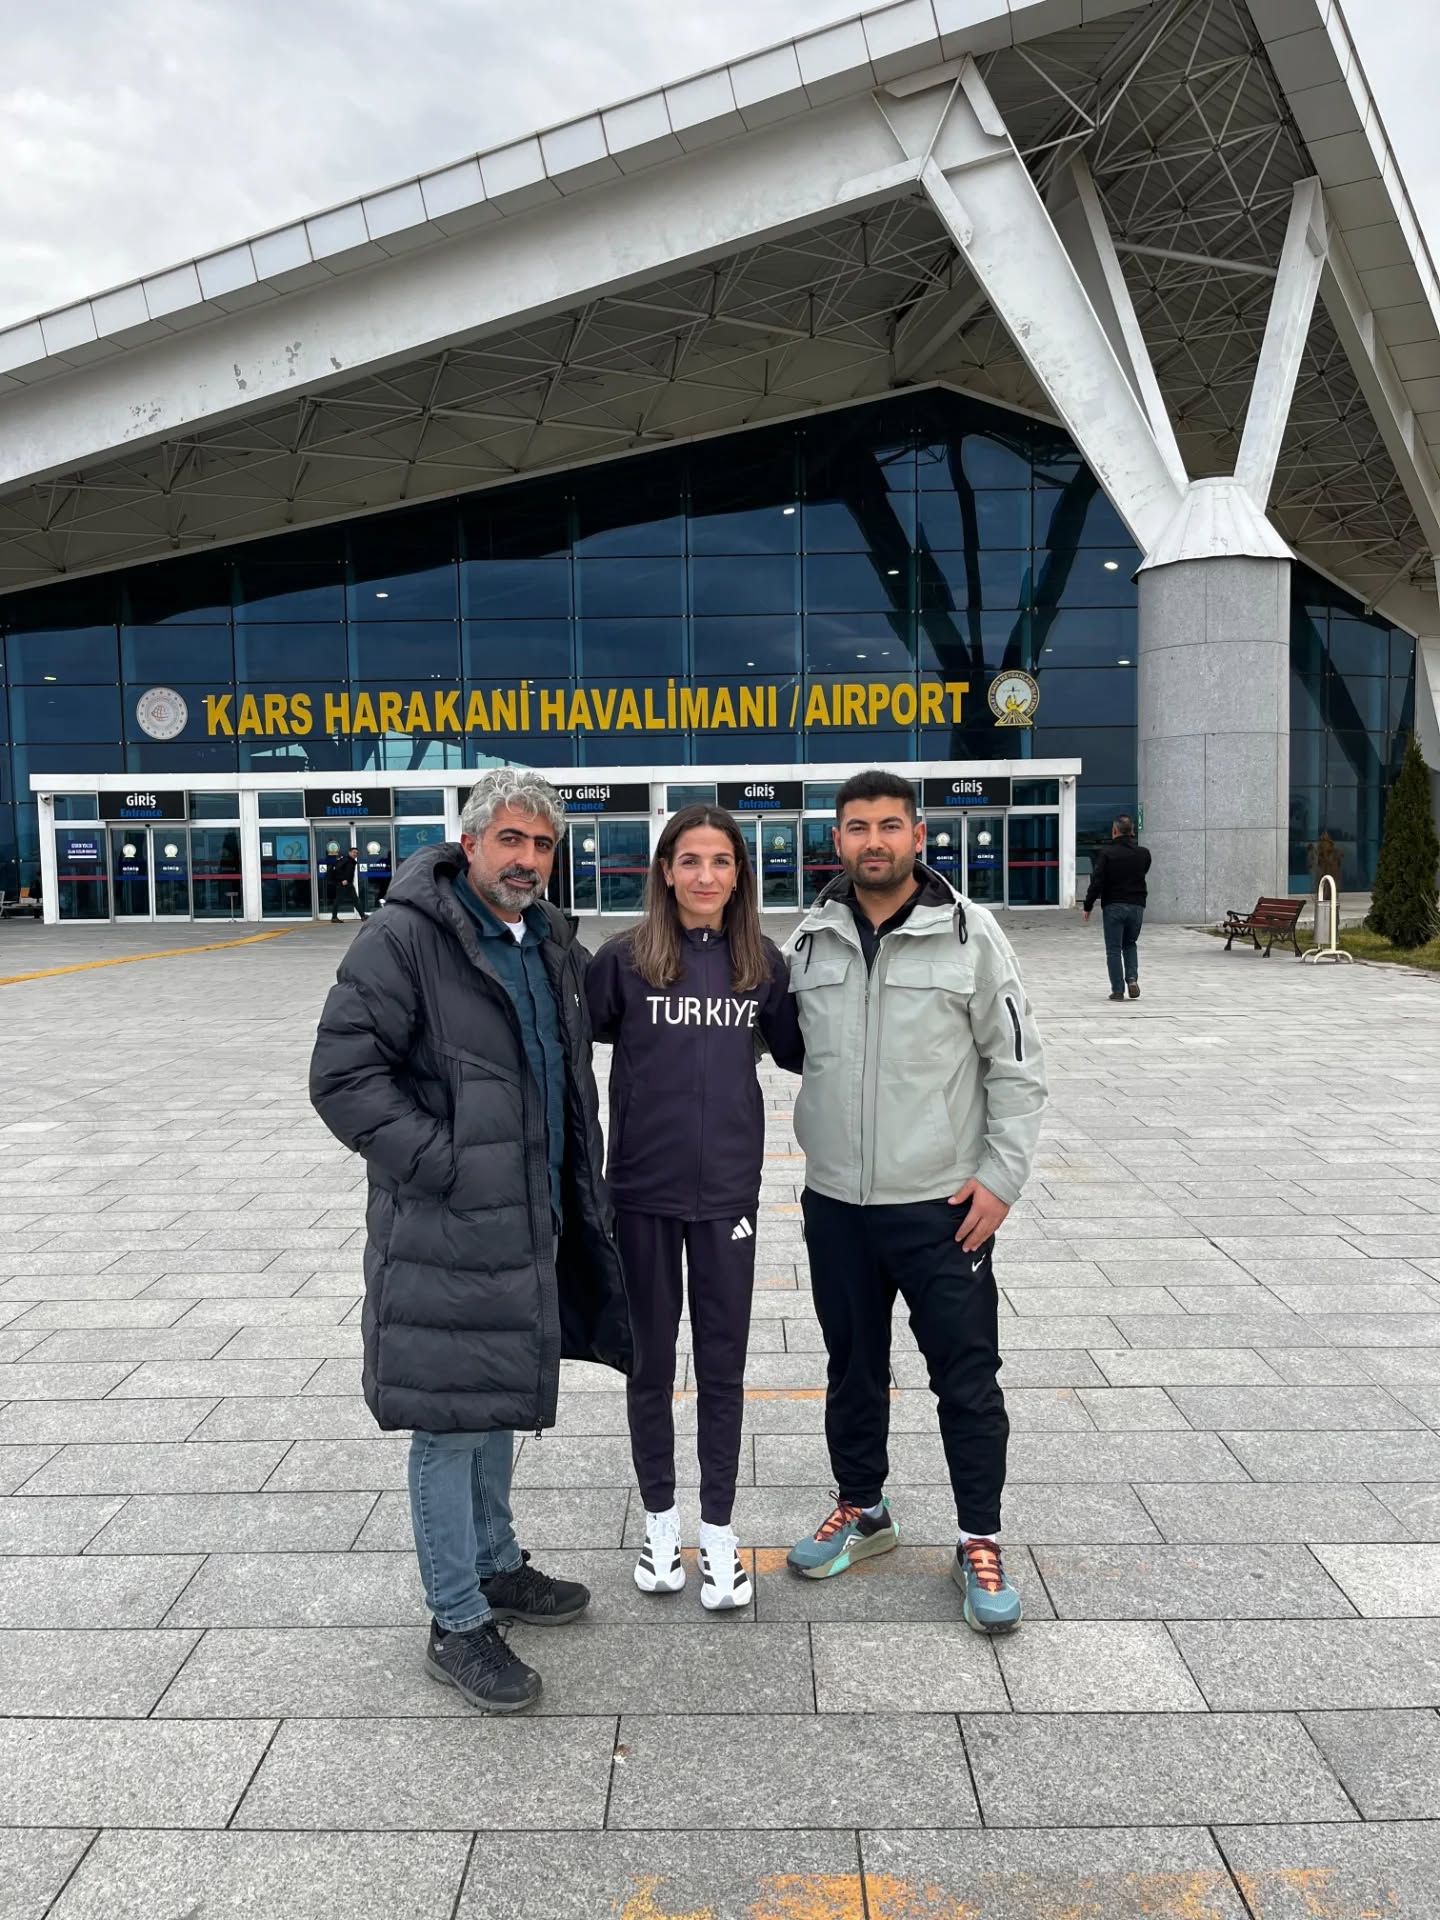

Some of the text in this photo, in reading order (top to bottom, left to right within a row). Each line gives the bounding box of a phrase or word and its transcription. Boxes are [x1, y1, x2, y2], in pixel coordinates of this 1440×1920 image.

[206, 693, 313, 736] KARS
[324, 680, 530, 734] HARAKANİ
[540, 679, 777, 731] HAVALİMANI
[575, 785, 611, 802] GİRİŞİ
[744, 783, 775, 800] GİRİŞ
[951, 779, 983, 796] GİRİŞ
[126, 792, 157, 809] GİRİŞ
[331, 790, 363, 807] GİRİŞ
[739, 800, 781, 809] Entrance
[946, 796, 989, 804] Entrance
[120, 808, 163, 818] Entrance
[326, 806, 369, 816] Entrance
[646, 996, 759, 1028] TÜRKİYE
